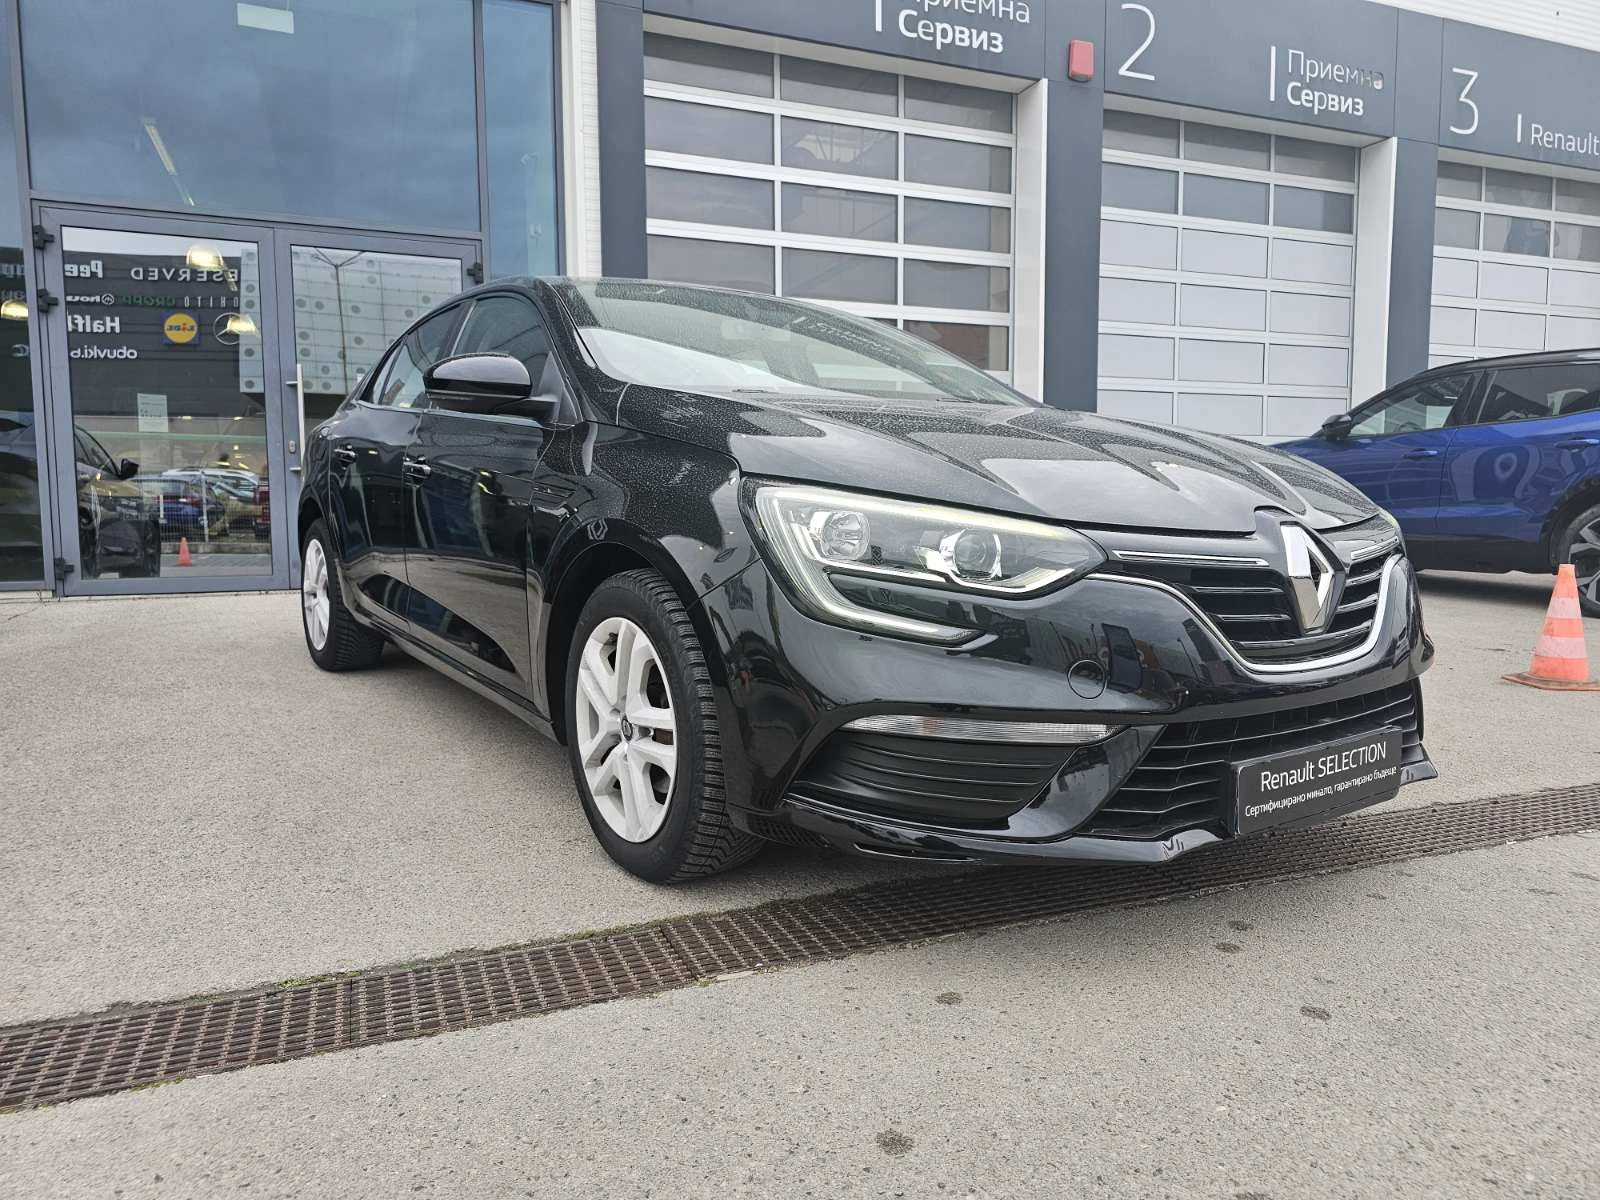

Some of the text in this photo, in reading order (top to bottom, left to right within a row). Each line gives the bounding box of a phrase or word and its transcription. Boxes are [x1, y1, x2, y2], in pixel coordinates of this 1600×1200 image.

[898, 9, 1004, 53] Сервиз
[916, 0, 1030, 24] емна
[1118, 3, 1155, 81] 2
[1288, 48, 1384, 90] Приемна
[1287, 81, 1364, 116] Сервиз
[1449, 67, 1479, 135] 3
[1531, 123, 1600, 156] Renault
[1260, 741, 1387, 792] Renault SELECTION
[1245, 766, 1397, 817] Сертифицирано минало, гарантирано бъдеще
